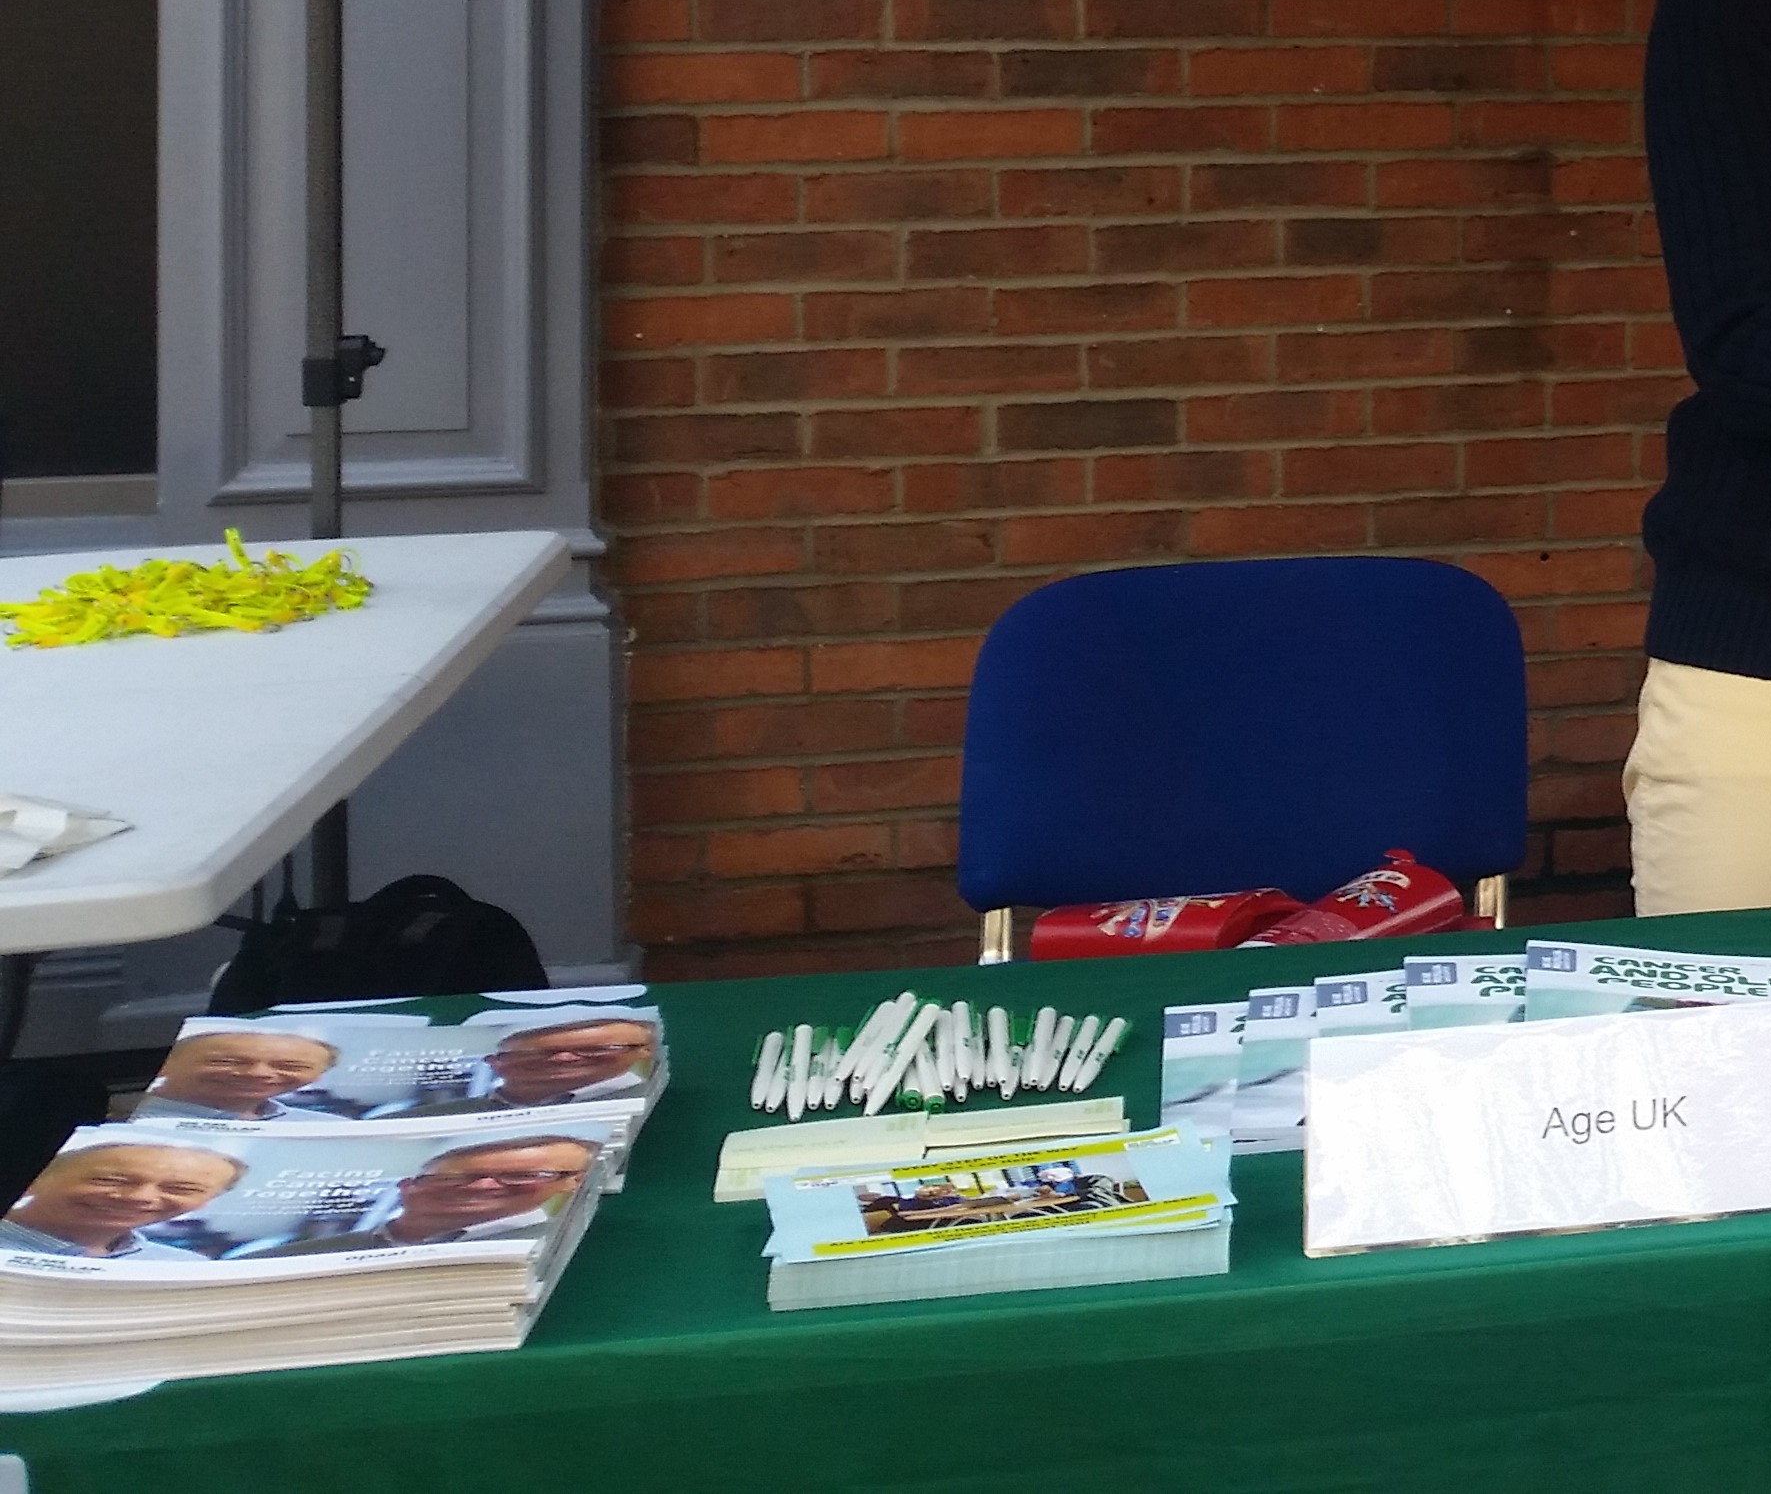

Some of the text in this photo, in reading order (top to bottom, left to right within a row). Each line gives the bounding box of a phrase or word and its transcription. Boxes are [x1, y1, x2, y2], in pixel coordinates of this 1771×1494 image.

[1588, 964, 1710, 984] AND
[1593, 955, 1741, 977] CANCER
[1596, 976, 1768, 998] PEOPLE
[1542, 1096, 1687, 1144] Age UK
[265, 1179, 380, 1189] Cancer
[278, 1169, 384, 1179] Facing
[242, 1187, 389, 1199] Together
